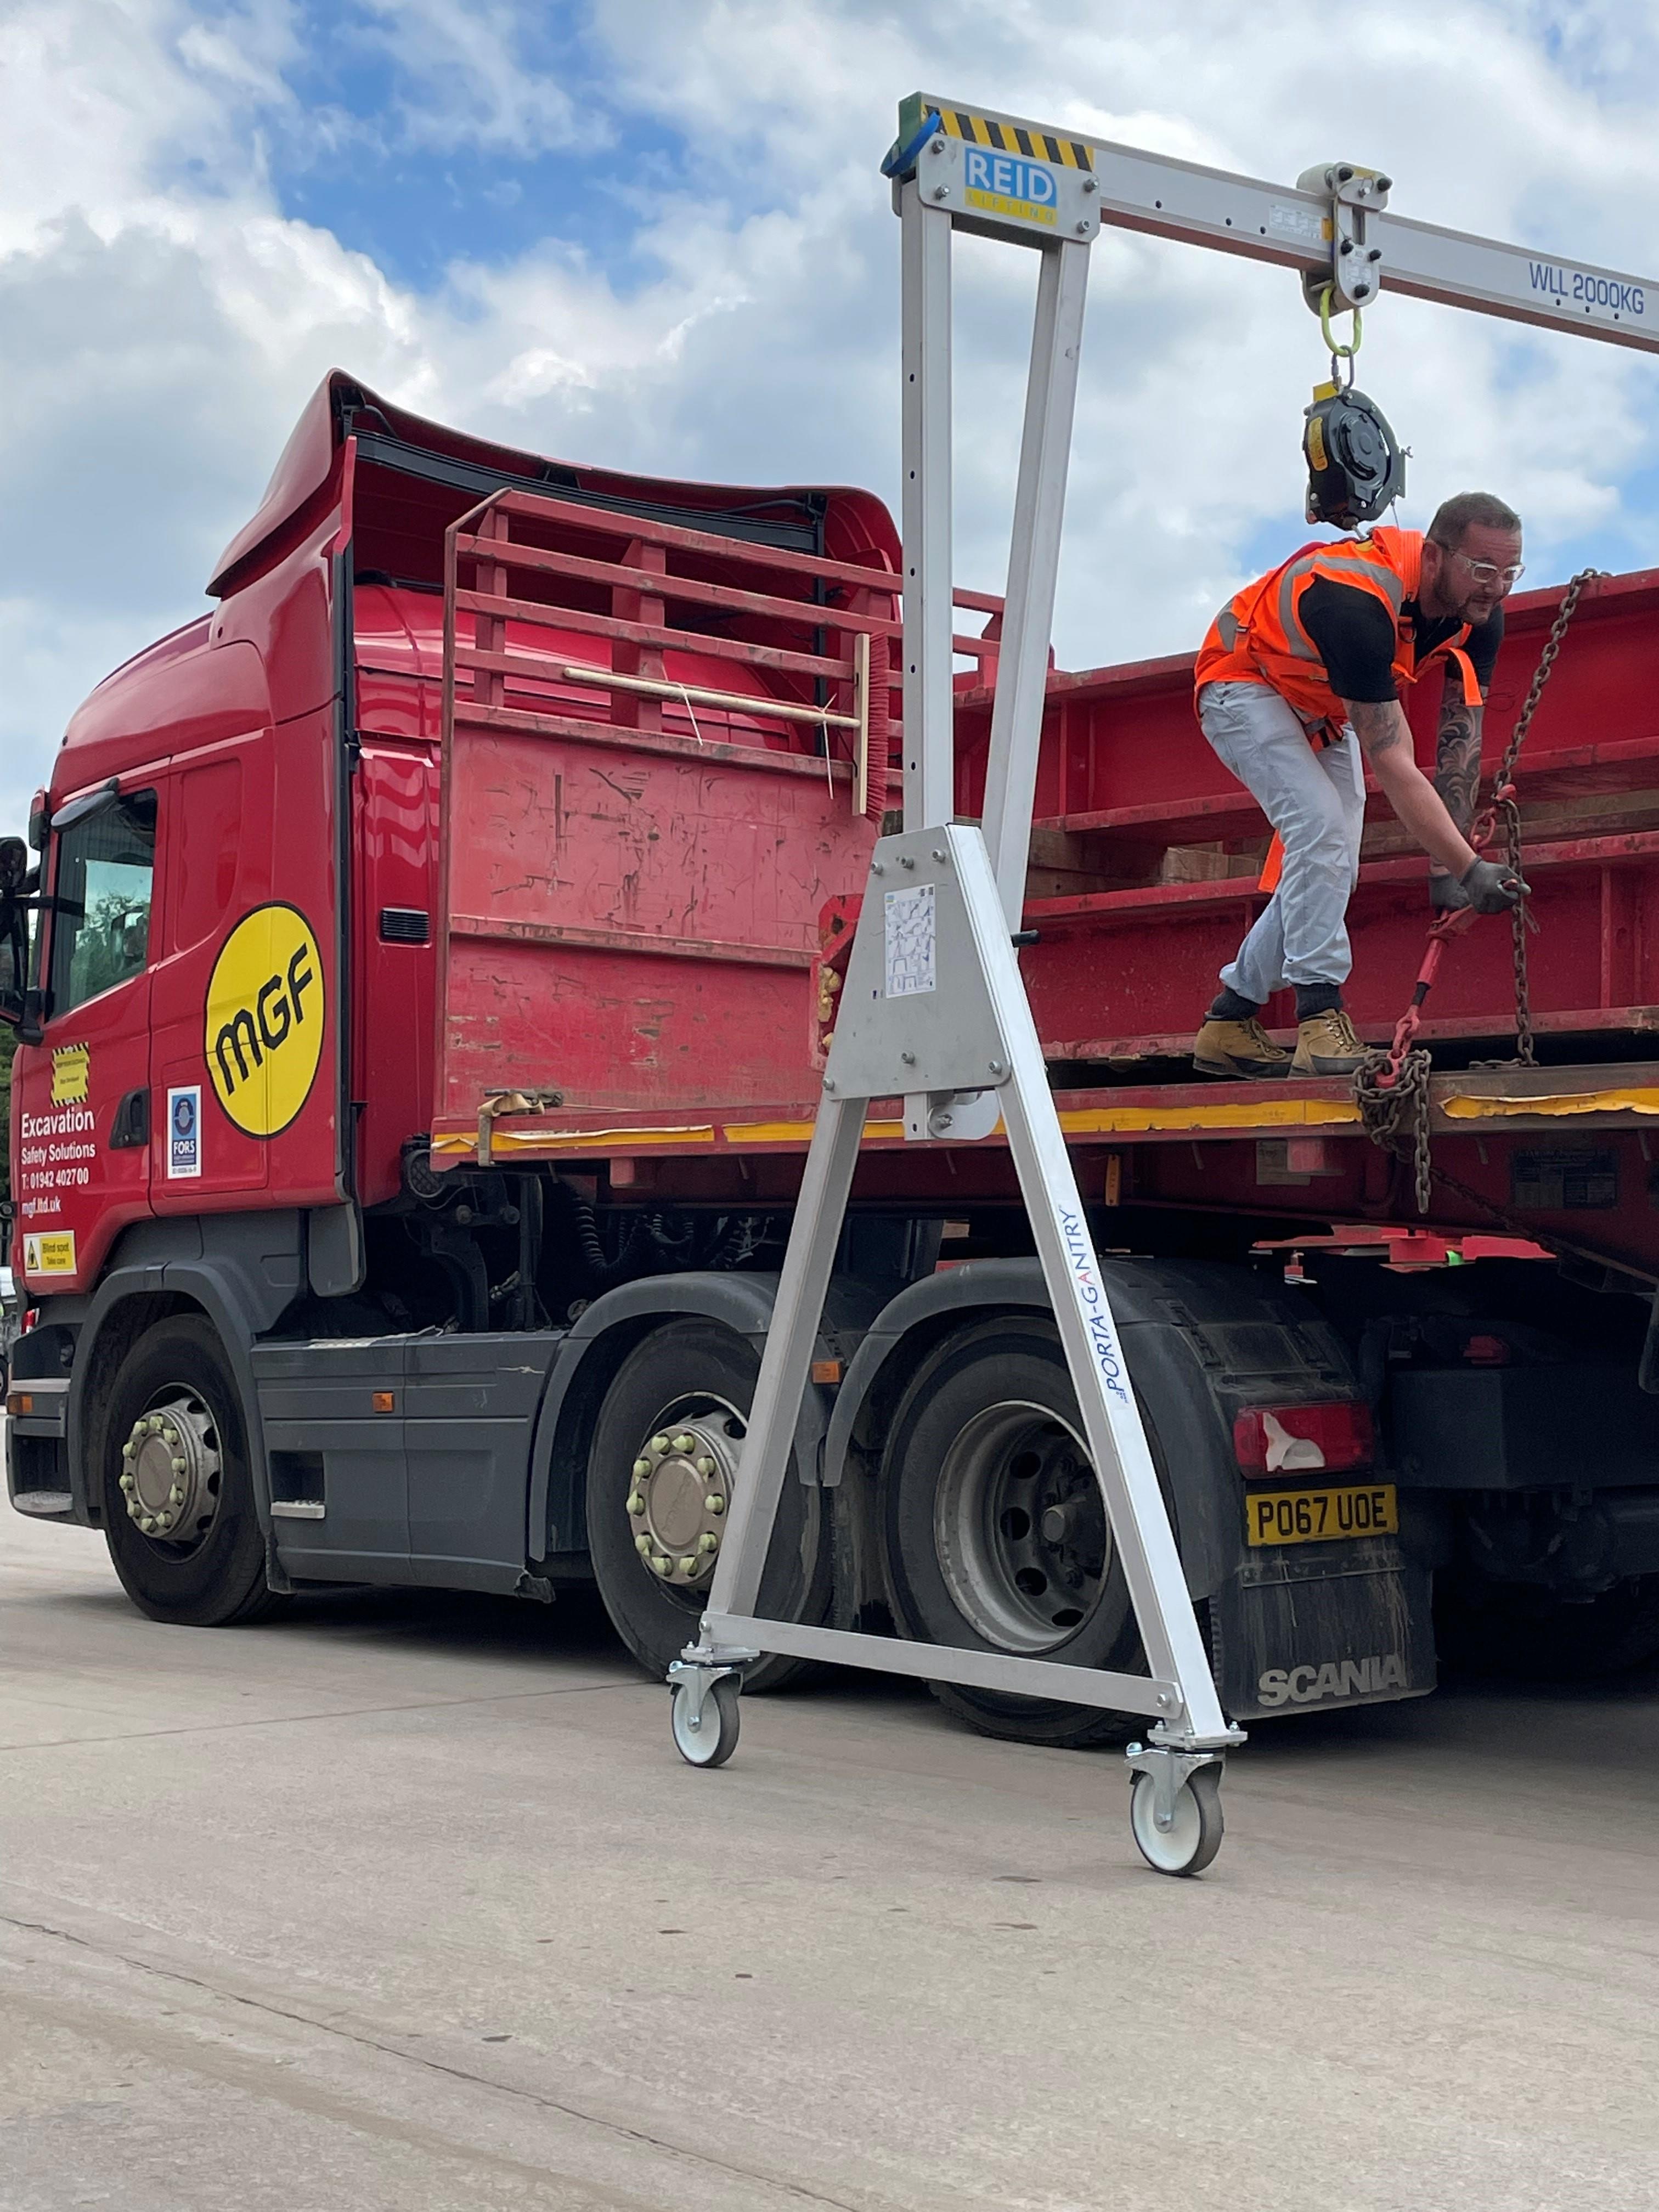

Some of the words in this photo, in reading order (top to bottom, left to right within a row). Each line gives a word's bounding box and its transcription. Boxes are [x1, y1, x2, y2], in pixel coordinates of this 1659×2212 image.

[969, 153, 1053, 203] REID
[969, 192, 1053, 221] LIFTING
[1529, 262, 1568, 296] WLL
[1573, 273, 1644, 314] 2000KG
[216, 942, 313, 1097] MGF
[21, 1107, 95, 1138] Excavation
[21, 1146, 47, 1167] Safety
[49, 1141, 95, 1161] Solutions
[173, 1141, 195, 1155] FORS
[30, 1171, 54, 1189] 01942
[55, 1167, 89, 1187] 402700
[42, 1243, 55, 1254] Blind
[57, 1242, 70, 1255] spot
[1059, 1208, 1125, 1392] PORTA-GANTRY
[1257, 1496, 1328, 1538] PO67
[1337, 1492, 1387, 1531] UOE
[1257, 1654, 1408, 1707] SCANIA
